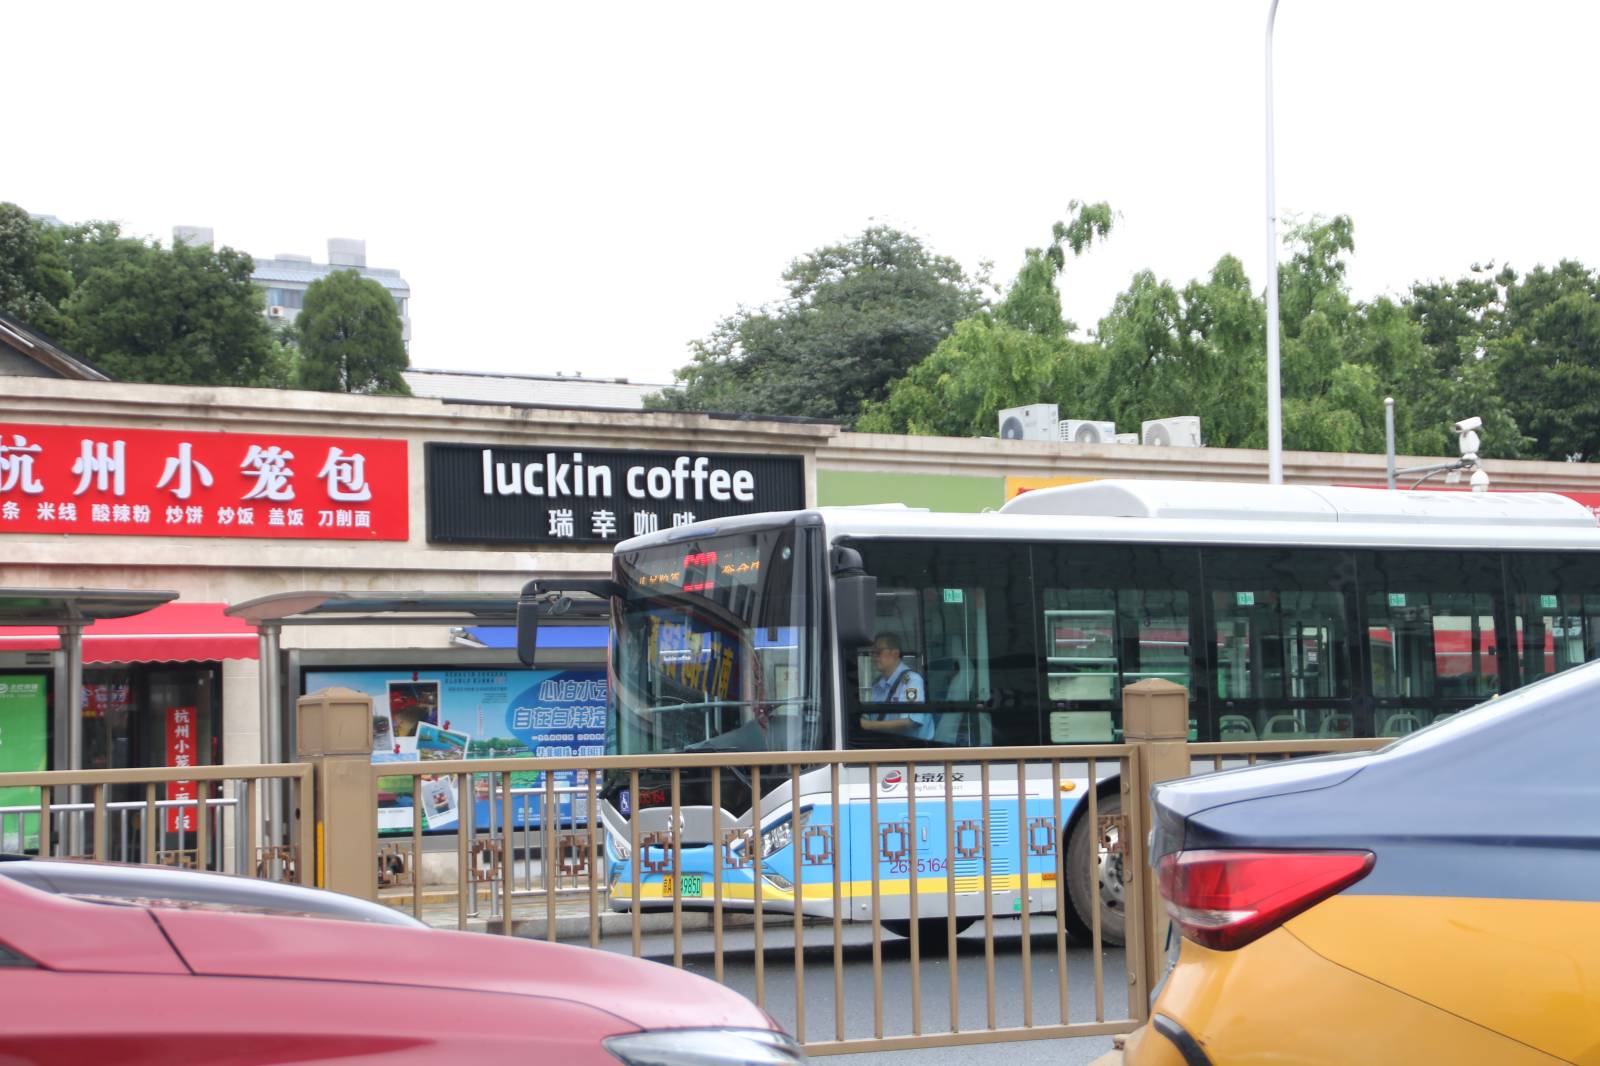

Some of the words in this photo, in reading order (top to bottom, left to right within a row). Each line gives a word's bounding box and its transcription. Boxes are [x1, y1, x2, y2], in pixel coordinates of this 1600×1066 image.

[0, 434, 372, 501] 杭州小笼包
[482, 449, 611, 497] luckin
[626, 457, 754, 501] coffee
[2, 501, 20, 520] 条
[37, 502, 77, 521] 米线
[91, 503, 151, 523] 酸辣粉
[165, 505, 203, 524] 炒饼
[217, 507, 254, 525] 炒饭
[268, 508, 304, 526] 盖饭
[318, 509, 371, 527] 刀削面
[890, 858, 948, 873] 265164
